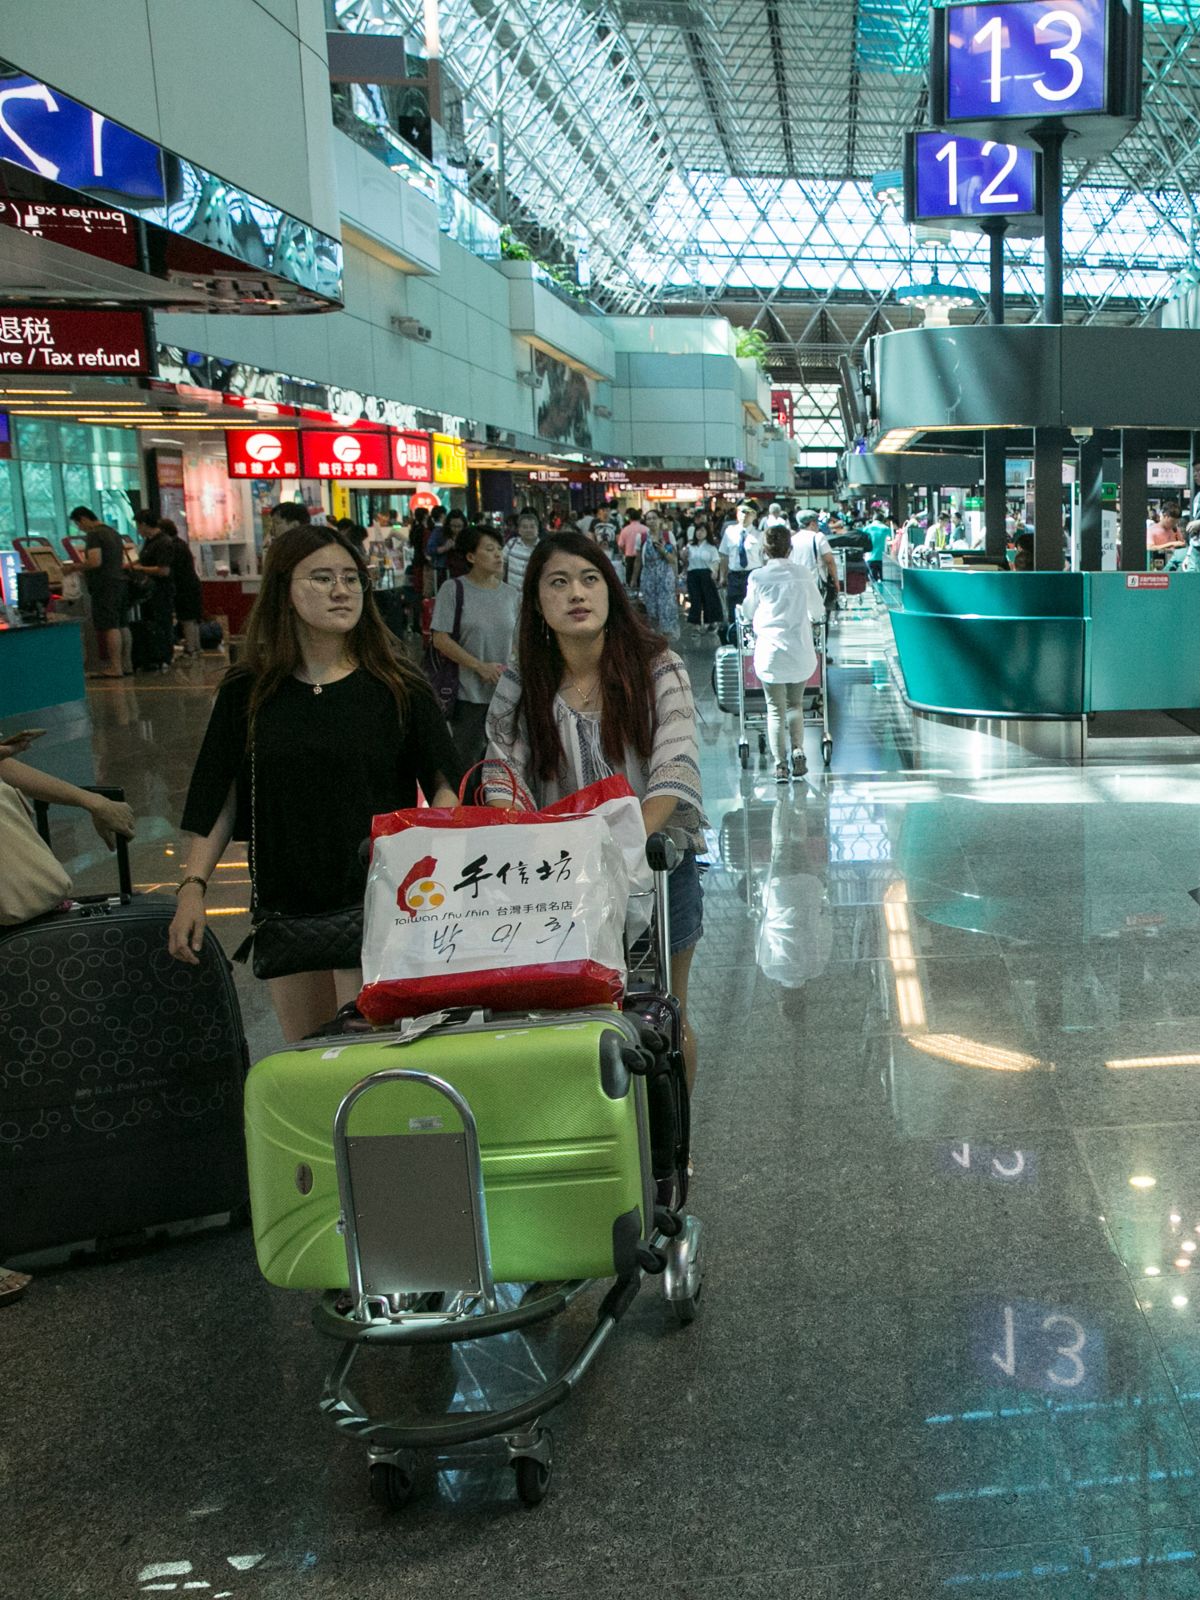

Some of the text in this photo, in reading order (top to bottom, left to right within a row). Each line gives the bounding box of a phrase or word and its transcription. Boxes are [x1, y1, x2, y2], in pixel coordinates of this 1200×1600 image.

[974, 10, 1083, 103] 13
[936, 140, 1018, 206] 12
[39, 348, 73, 365] Tax
[78, 348, 140, 367] refund
[453, 850, 572, 898] 手信坊
[395, 914, 438, 926] Taiwan
[496, 901, 573, 916] 台灣手信名店
